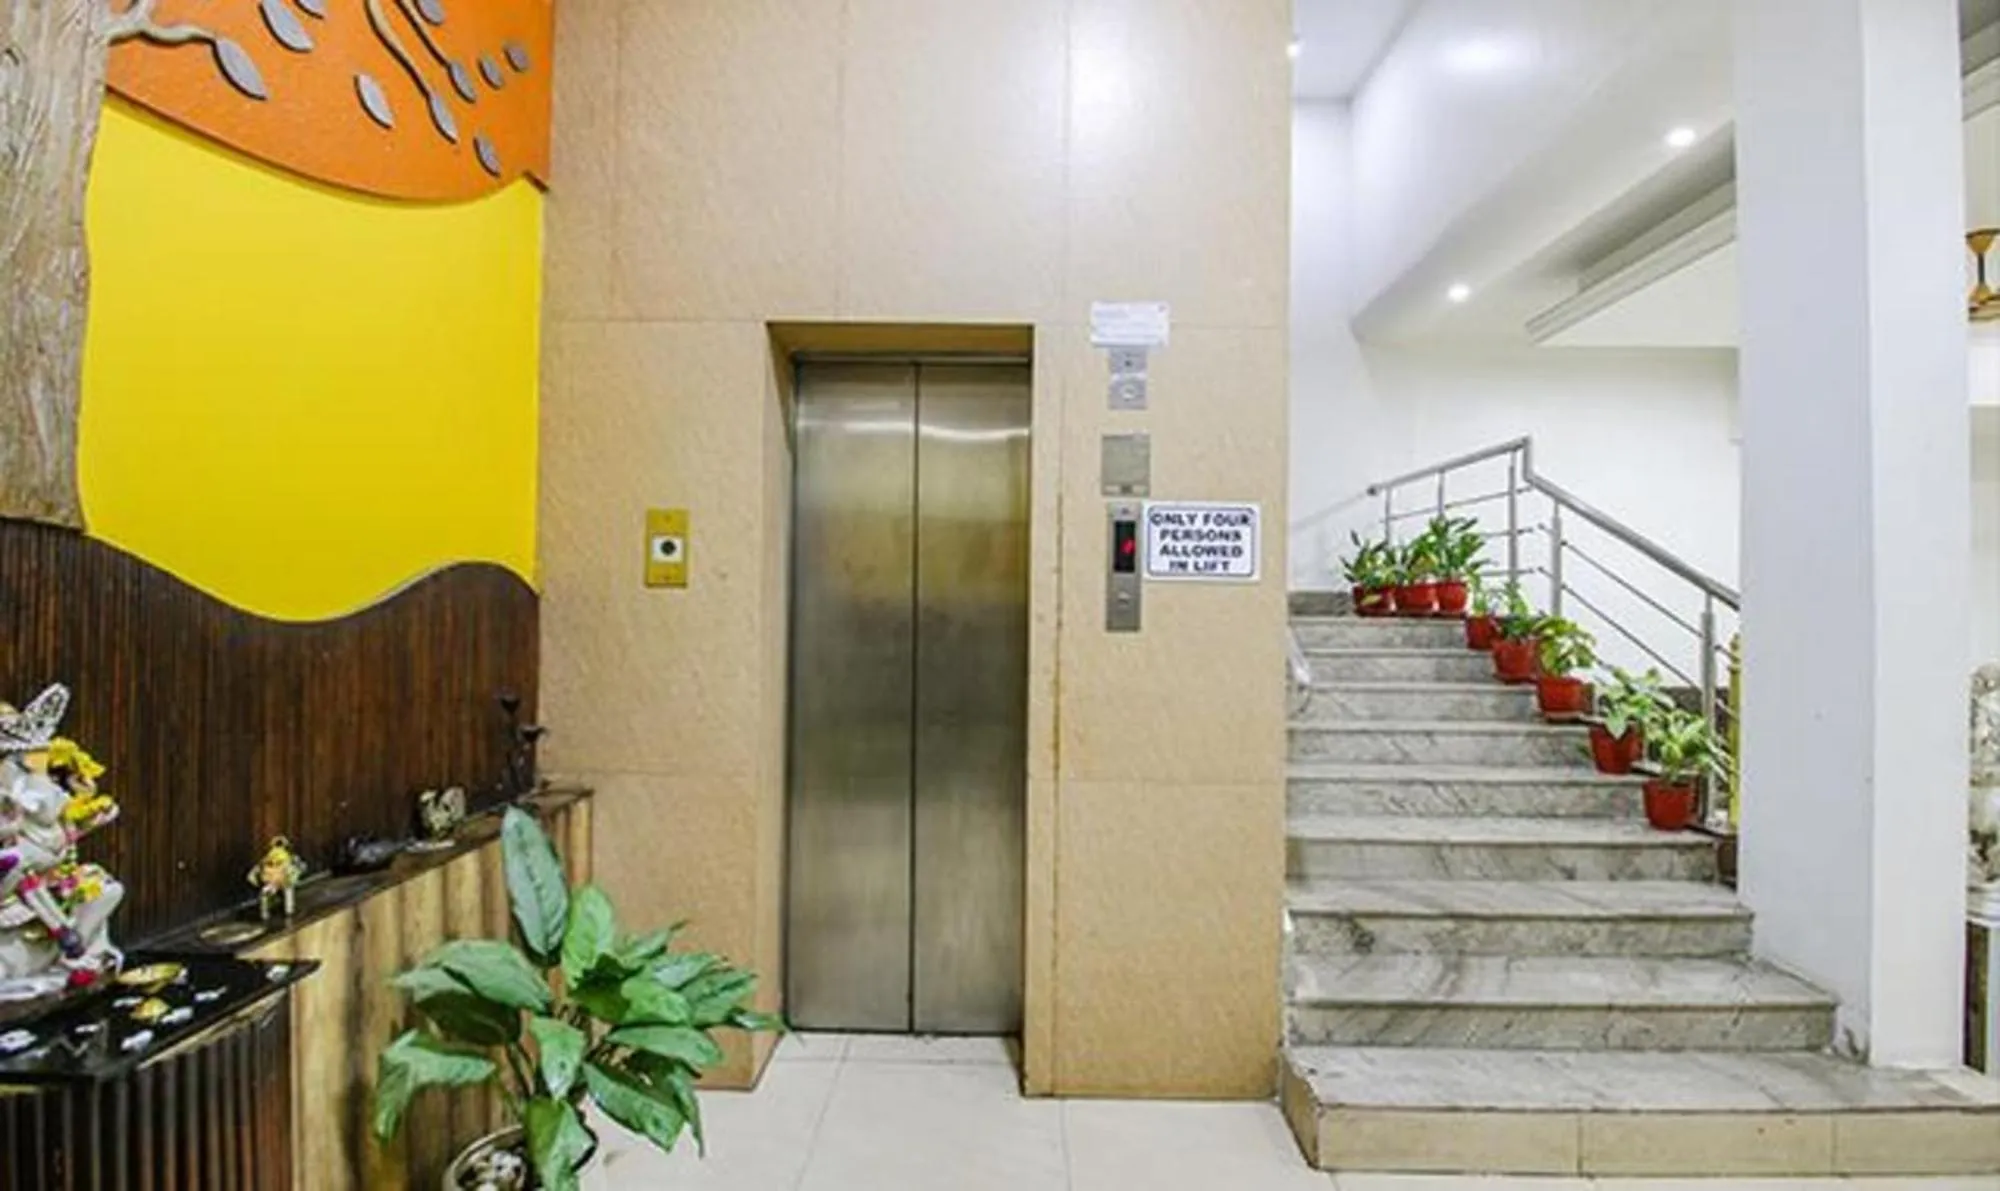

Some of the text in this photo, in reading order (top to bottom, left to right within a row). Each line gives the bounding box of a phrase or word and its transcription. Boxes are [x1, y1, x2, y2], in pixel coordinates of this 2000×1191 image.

[1150, 513, 1249, 526] ONLY FOUR
[1160, 529, 1242, 541] PERSONS
[1159, 545, 1243, 557] ALLOWED
[1169, 561, 1230, 571] IN LIFT
